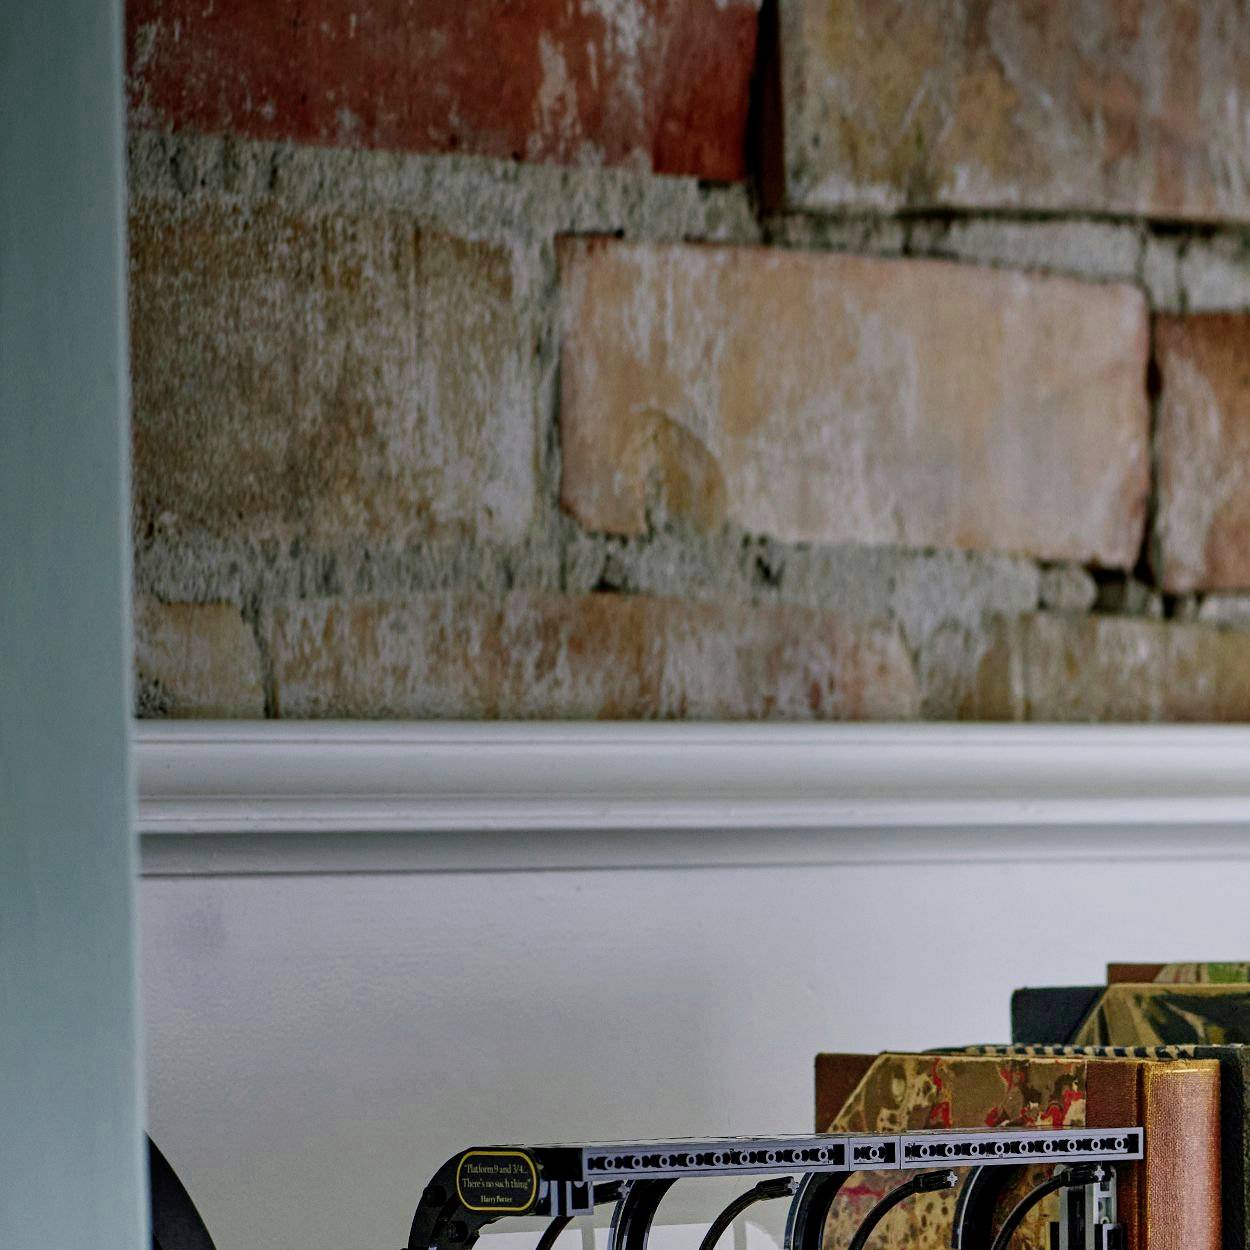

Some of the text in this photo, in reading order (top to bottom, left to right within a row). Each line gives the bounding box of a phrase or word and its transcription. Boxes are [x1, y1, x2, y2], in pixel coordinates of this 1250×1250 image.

[499, 1164, 512, 1174] and
[462, 1178, 485, 1188] There's
[495, 1178, 510, 1188] such
[480, 1195, 496, 1204] Harry
